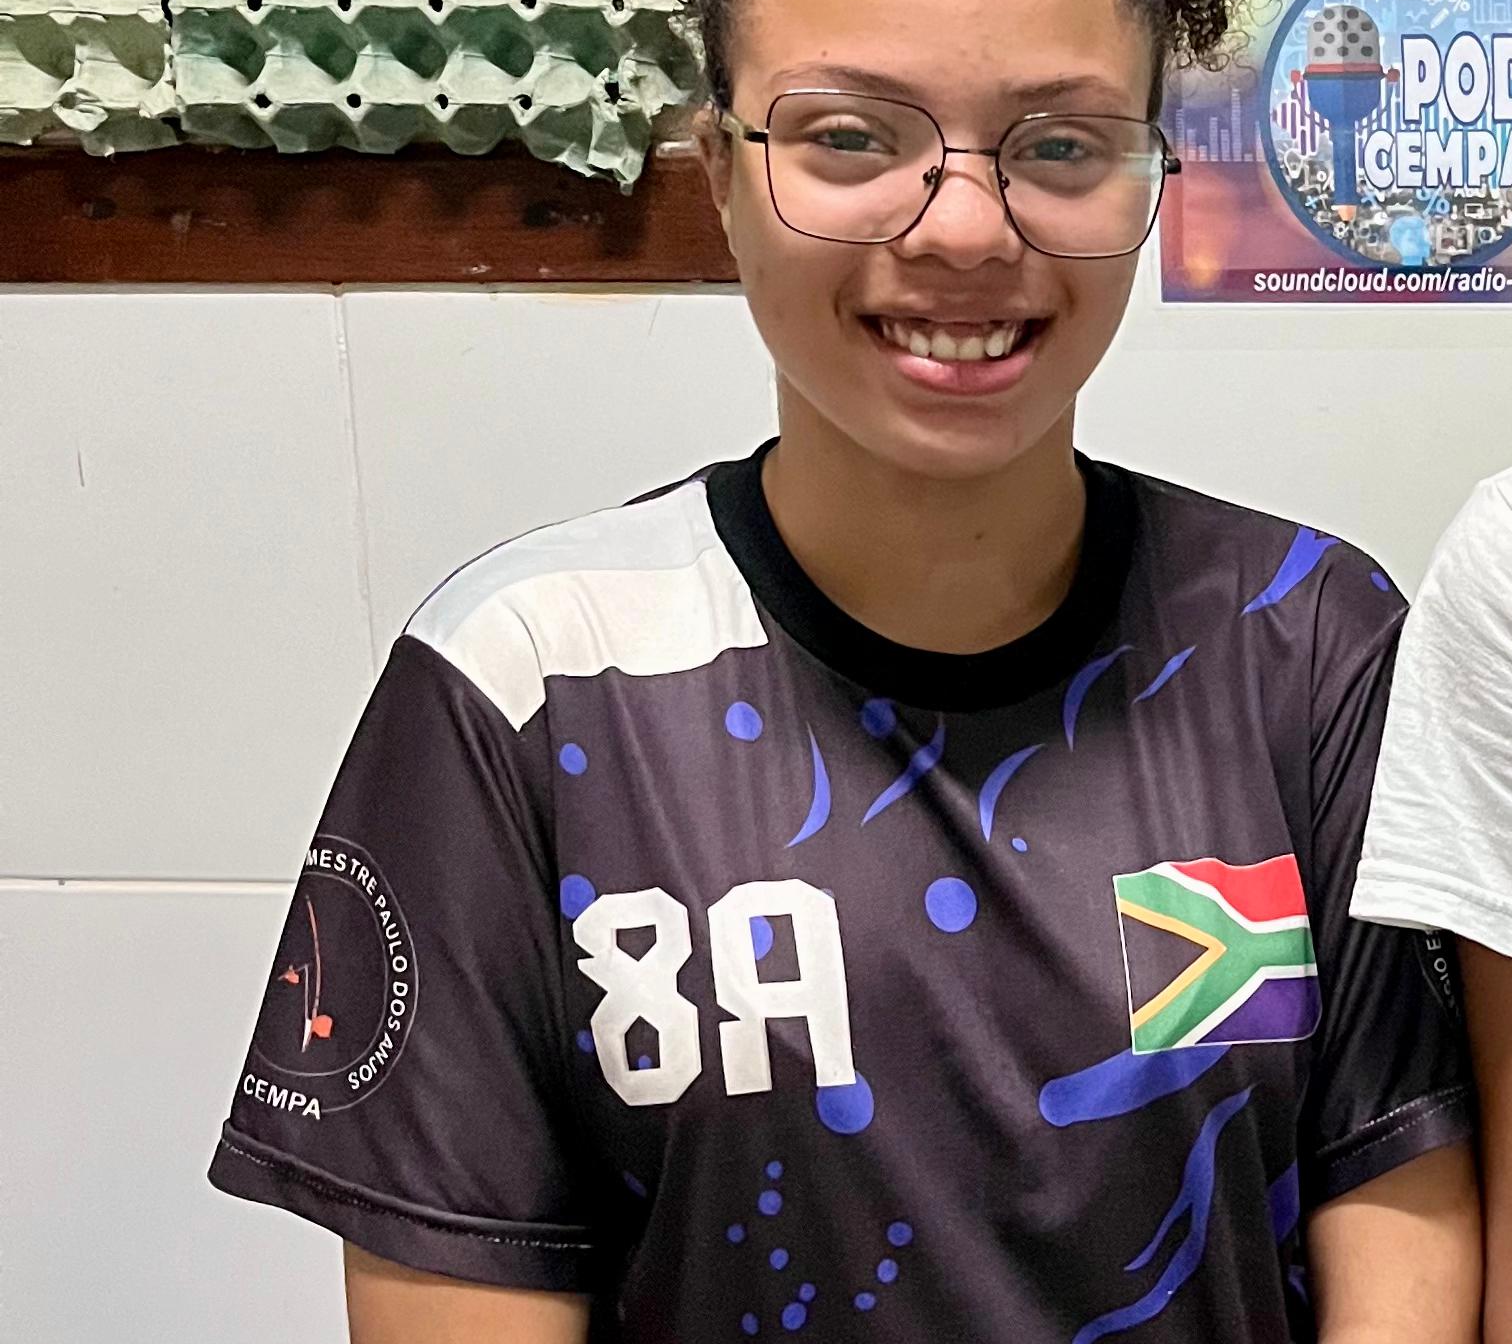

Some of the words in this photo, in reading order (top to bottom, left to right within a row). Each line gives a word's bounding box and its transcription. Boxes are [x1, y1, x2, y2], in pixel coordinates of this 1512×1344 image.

[374, 894, 408, 973] PAULO
[387, 981, 409, 1032] DOS
[347, 1032, 394, 1091] ANJOS
[243, 1073, 321, 1121] CEMPA
